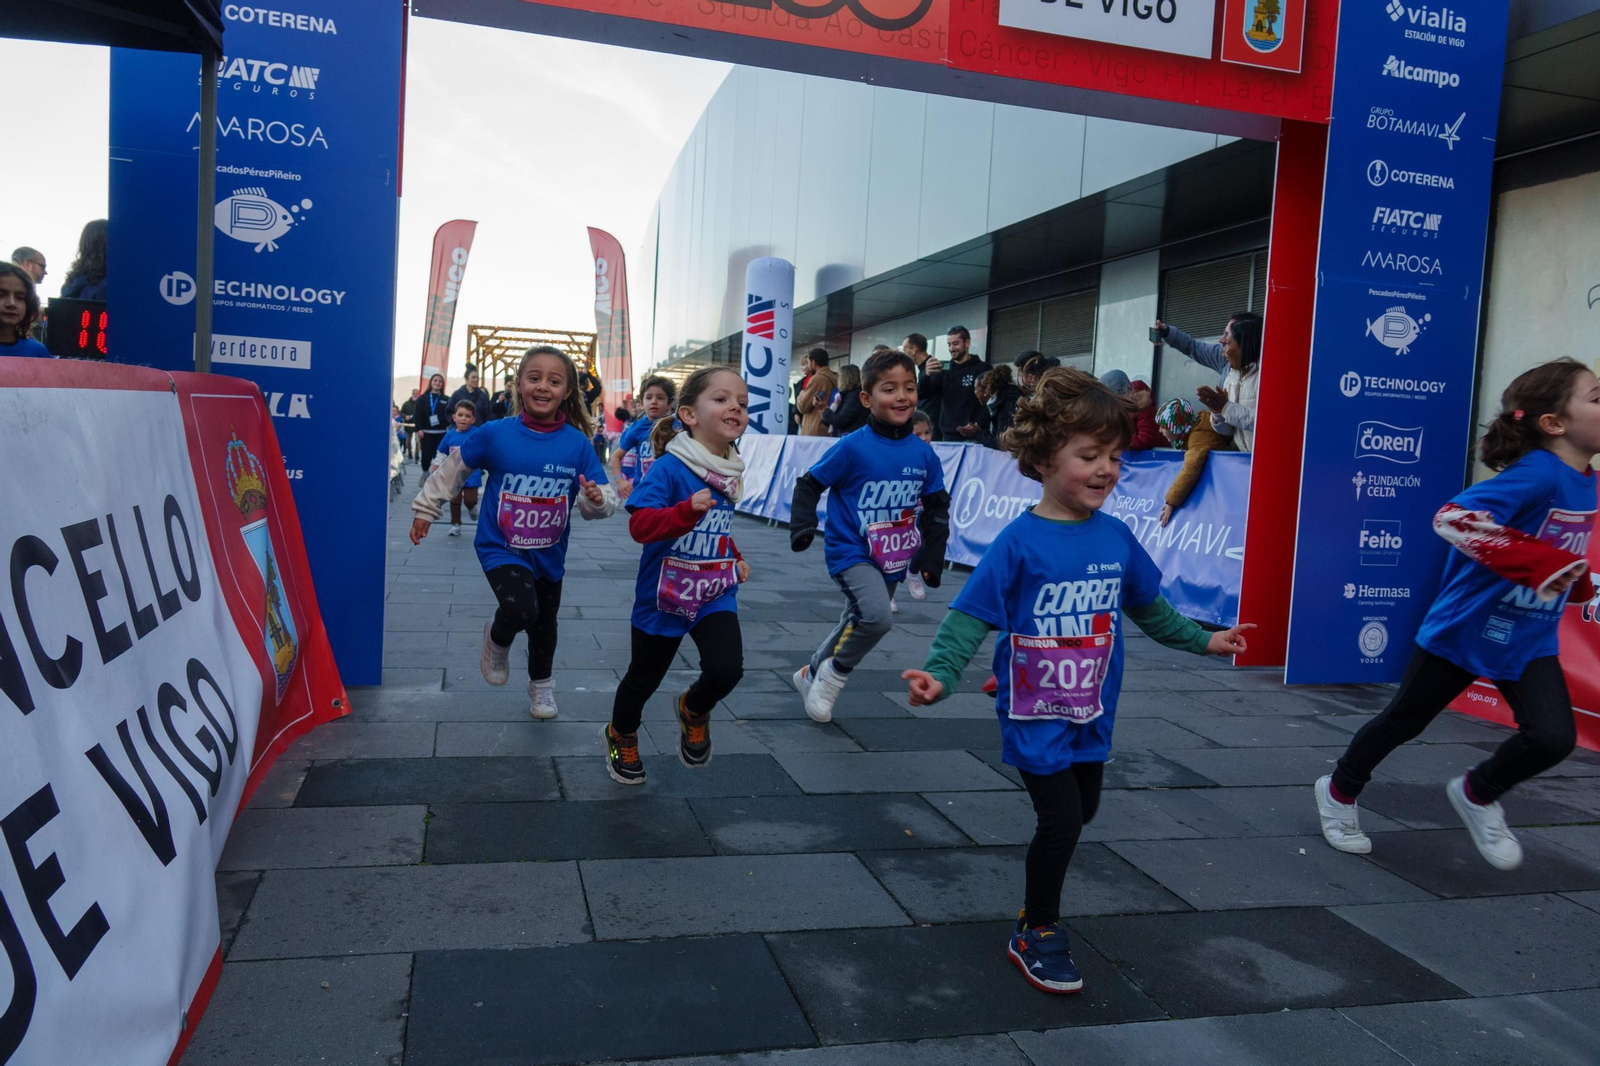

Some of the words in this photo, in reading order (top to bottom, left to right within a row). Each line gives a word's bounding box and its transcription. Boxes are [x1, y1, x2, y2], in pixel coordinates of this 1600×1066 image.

[224, 4, 338, 35] COTERENA
[824, 12, 863, 38] Ao
[1407, 6, 1468, 33] vialia
[1405, 29, 1436, 43] ESTACIÓN
[1438, 35, 1448, 45] DE
[1448, 37, 1466, 48] VIGO
[199, 55, 288, 86] IATC
[960, 29, 1061, 69] Cáncer
[1088, 51, 1147, 88] Vigo
[1223, 72, 1250, 99] La
[1382, 55, 1461, 88] Alcampo
[1371, 106, 1394, 117] GRUPO
[1367, 114, 1440, 138] BOTAMAVI
[216, 165, 302, 181] cadosPérezPiñeiro
[1391, 169, 1455, 189] COTERENA
[1372, 206, 1424, 229] FIATC
[1371, 224, 1438, 239] SEGUROS
[1361, 250, 1443, 275] MAROSA
[213, 279, 346, 305] ECHNOLOGY
[1368, 288, 1427, 301] PescadosPérezPiñeiro
[213, 299, 234, 308] UIPOS
[235, 301, 286, 312] INFORMÁTICOS
[774, 301, 790, 424] GUROS
[745, 342, 773, 434] ATC
[1364, 375, 1446, 394] TECHNOLOGY
[1368, 474, 1421, 488] FUNDACIÓN
[1367, 486, 1396, 498] CELTA
[1116, 495, 1154, 512] GRUPO
[513, 508, 561, 529] 2024
[511, 534, 552, 546] Alcampo
[881, 529, 917, 554] 2023
[1359, 529, 1403, 549] Feito
[1033, 577, 1121, 616] CORRER
[1358, 584, 1410, 598] Hermasa
[0, 494, 201, 716] CELLO
[1467, 690, 1498, 706] vigo.org
[1033, 699, 1094, 719] Alcampo
[85, 657, 238, 867] VIGO
